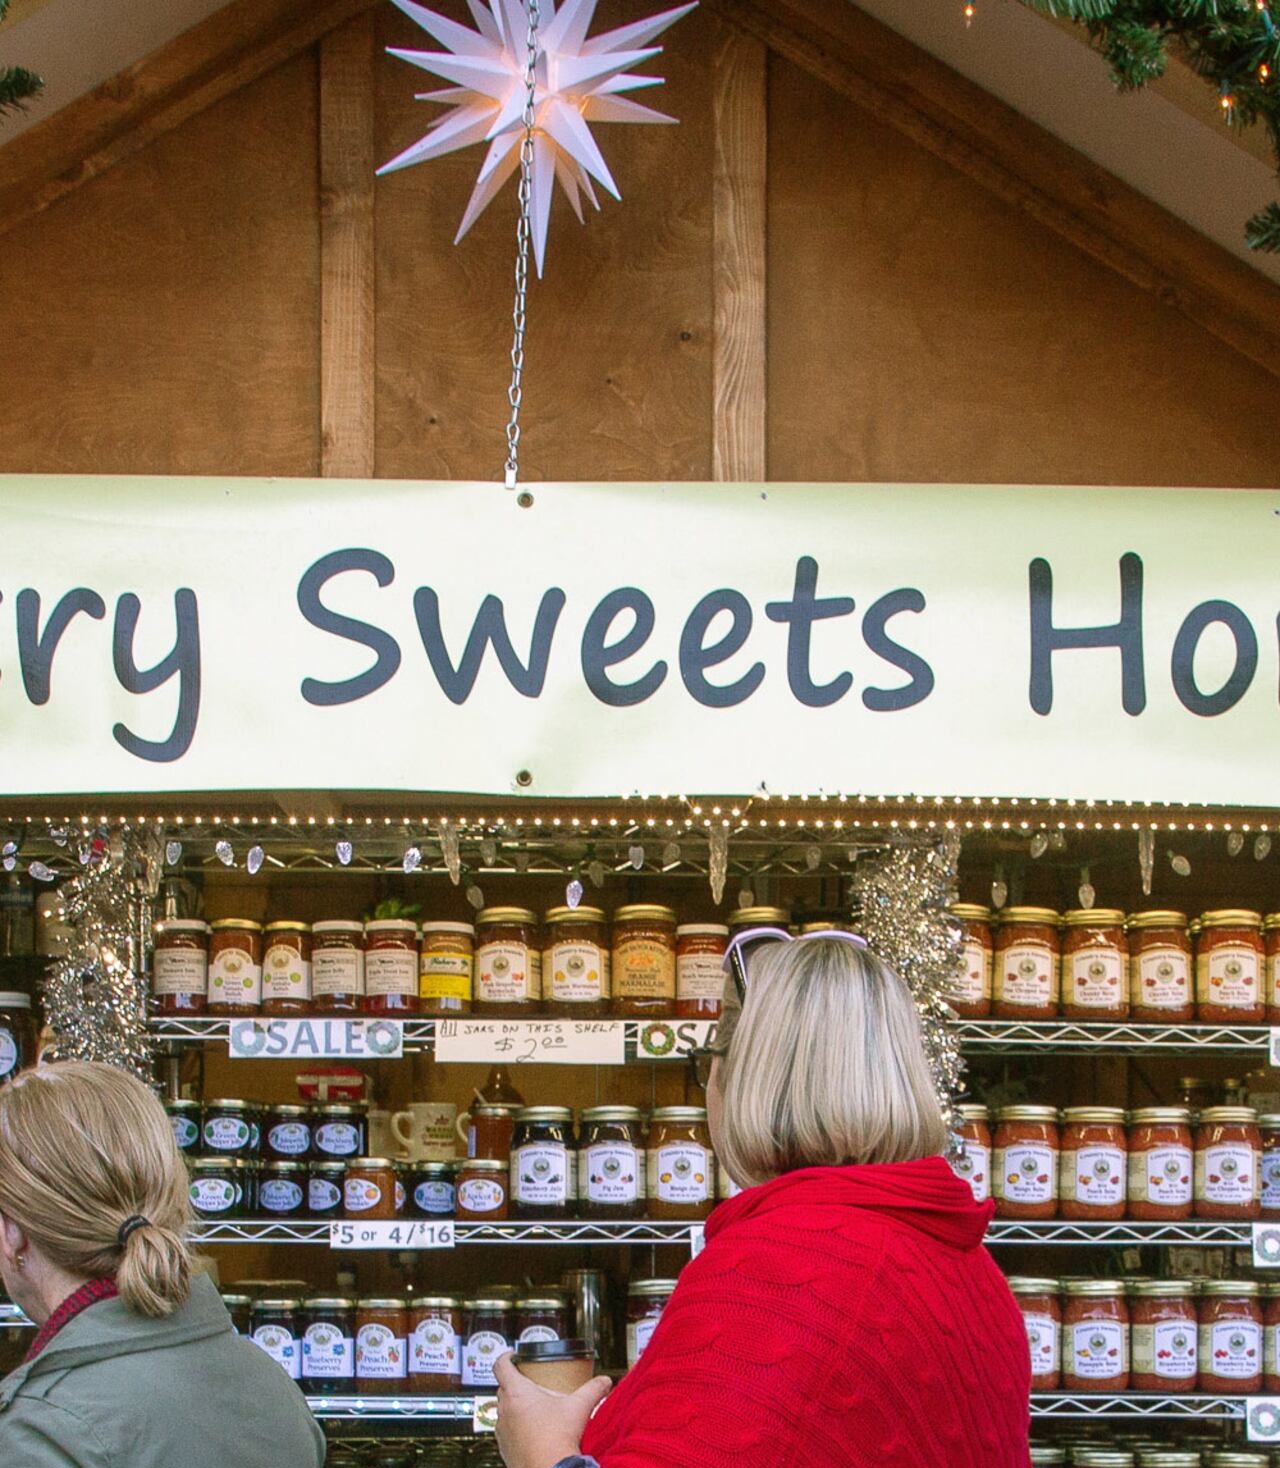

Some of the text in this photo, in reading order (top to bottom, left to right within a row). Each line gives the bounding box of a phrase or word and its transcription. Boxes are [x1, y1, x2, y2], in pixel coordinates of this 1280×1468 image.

[297, 547, 935, 712] Sweets
[265, 1020, 364, 1055] SALE
[526, 1023, 563, 1033] THIS
[676, 1022, 719, 1055] SA
[332, 1223, 354, 1245] $5
[360, 1230, 377, 1241] or
[363, 1355, 388, 1363] Peach
[424, 1352, 445, 1360] Peach
